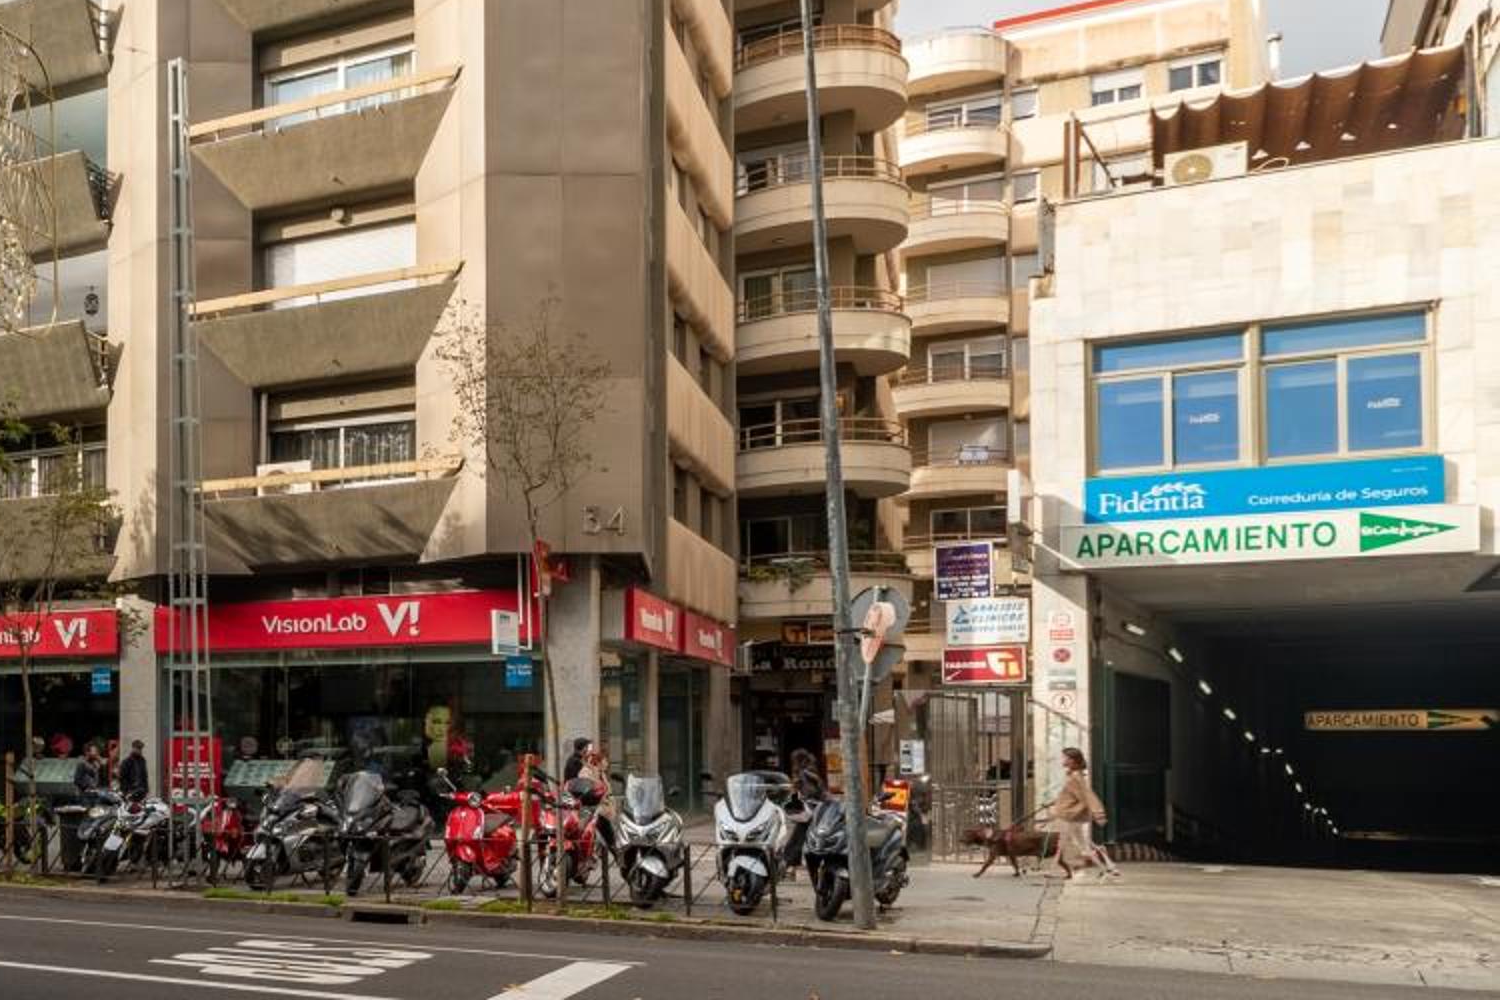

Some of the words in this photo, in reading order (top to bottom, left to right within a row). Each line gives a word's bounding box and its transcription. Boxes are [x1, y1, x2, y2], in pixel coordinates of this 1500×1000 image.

[1098, 490, 1205, 516] Fidentia
[1335, 488, 1357, 501] de
[1361, 485, 1429, 501] Seguros
[1077, 521, 1337, 559] APARCAMIENTO
[262, 612, 367, 635] VisionLab
[1306, 713, 1420, 728] APARCAMIENTO
